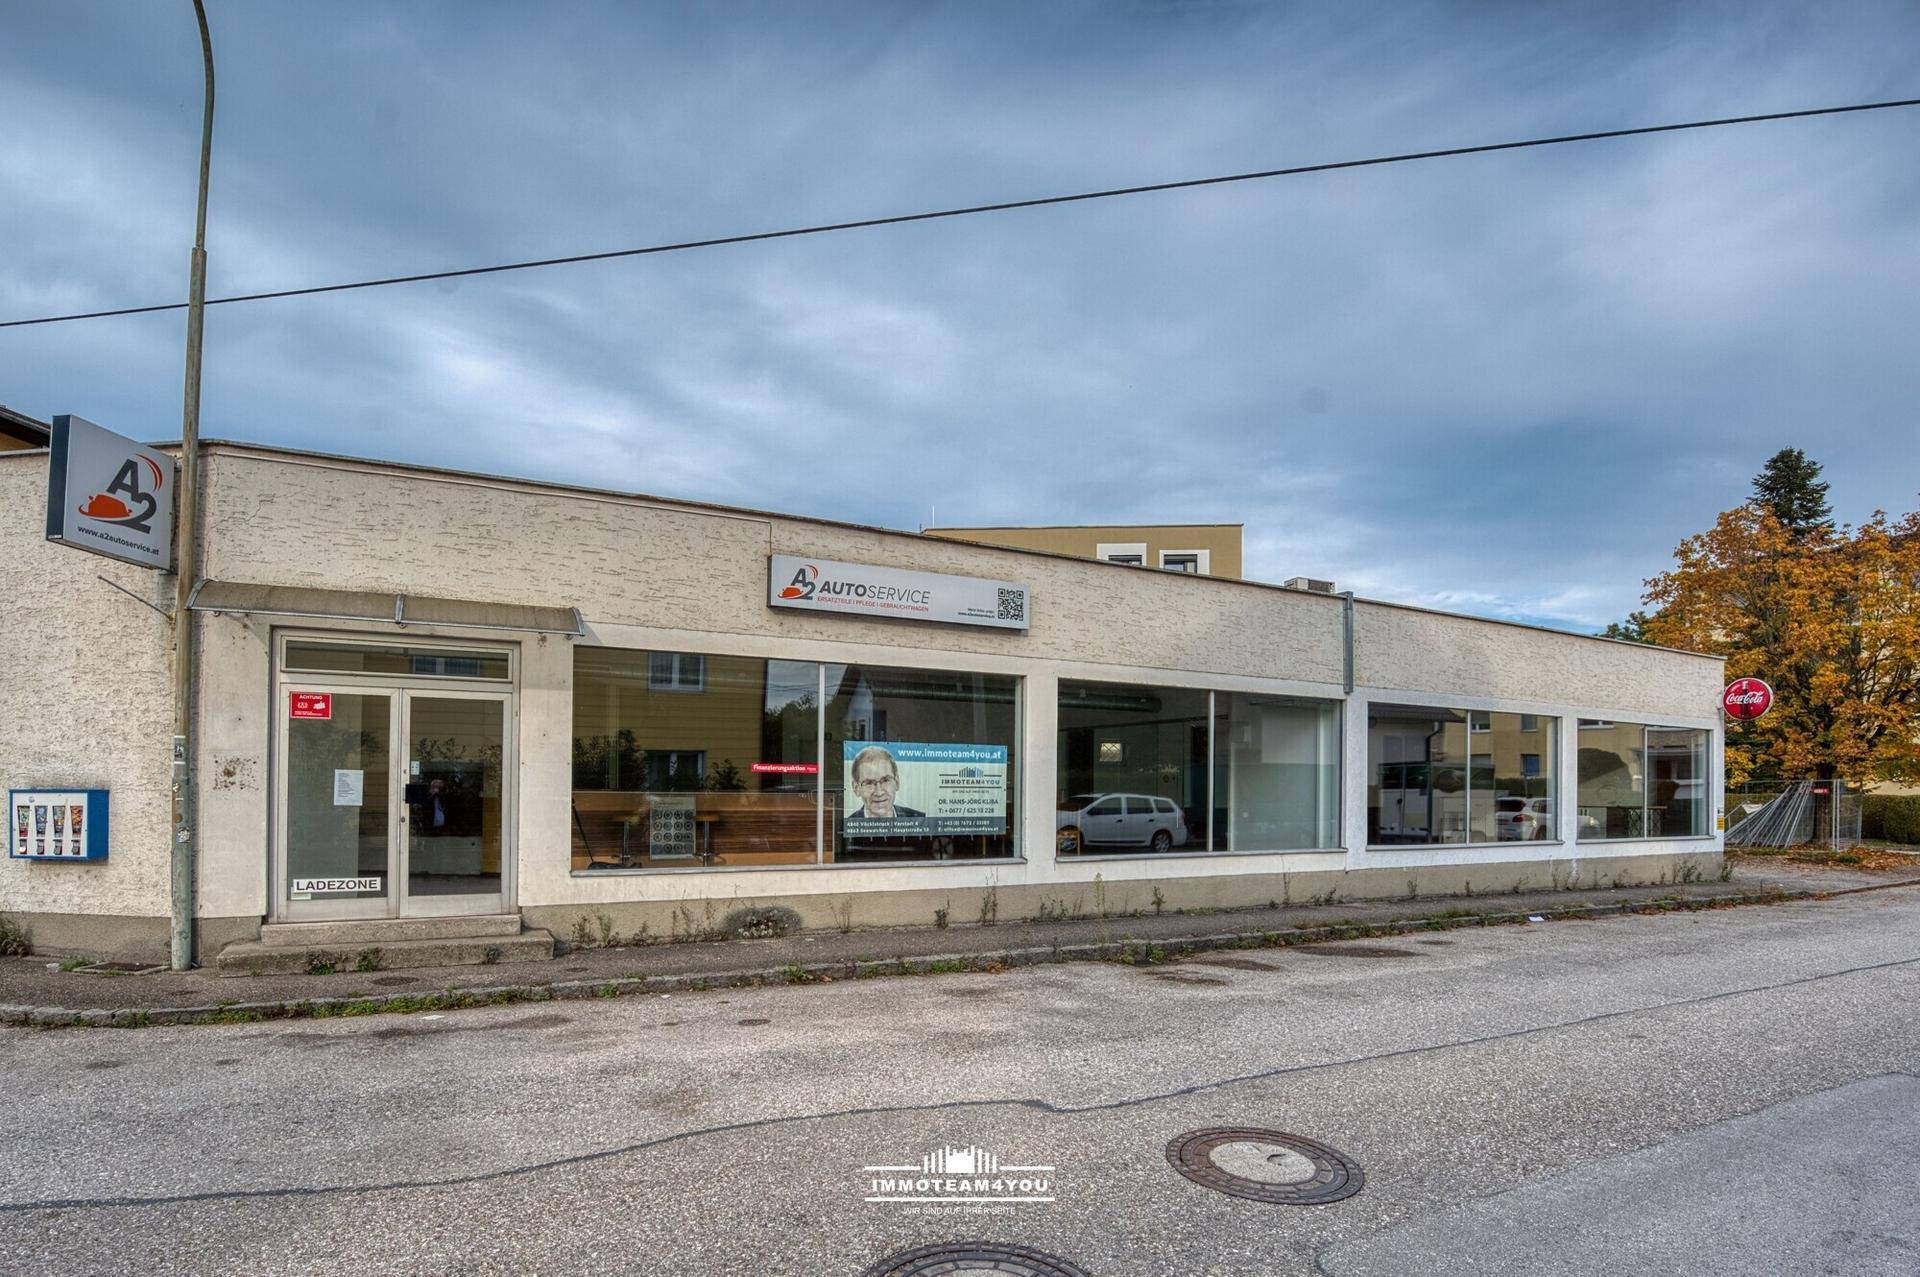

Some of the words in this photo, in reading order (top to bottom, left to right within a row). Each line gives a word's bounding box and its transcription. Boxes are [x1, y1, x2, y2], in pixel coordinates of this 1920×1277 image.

[105, 458, 157, 534] A2
[77, 525, 160, 556] www.a2autoservice.at
[791, 567, 816, 600] A2
[819, 580, 931, 605] AUTOSERVICE
[816, 595, 852, 605] ERSATZTEILE
[855, 600, 876, 608] PFLEGE
[898, 748, 1002, 761] www.immoteam4you.at
[753, 764, 806, 772] Finanzierungsaktion
[296, 879, 378, 891] LADEZONE
